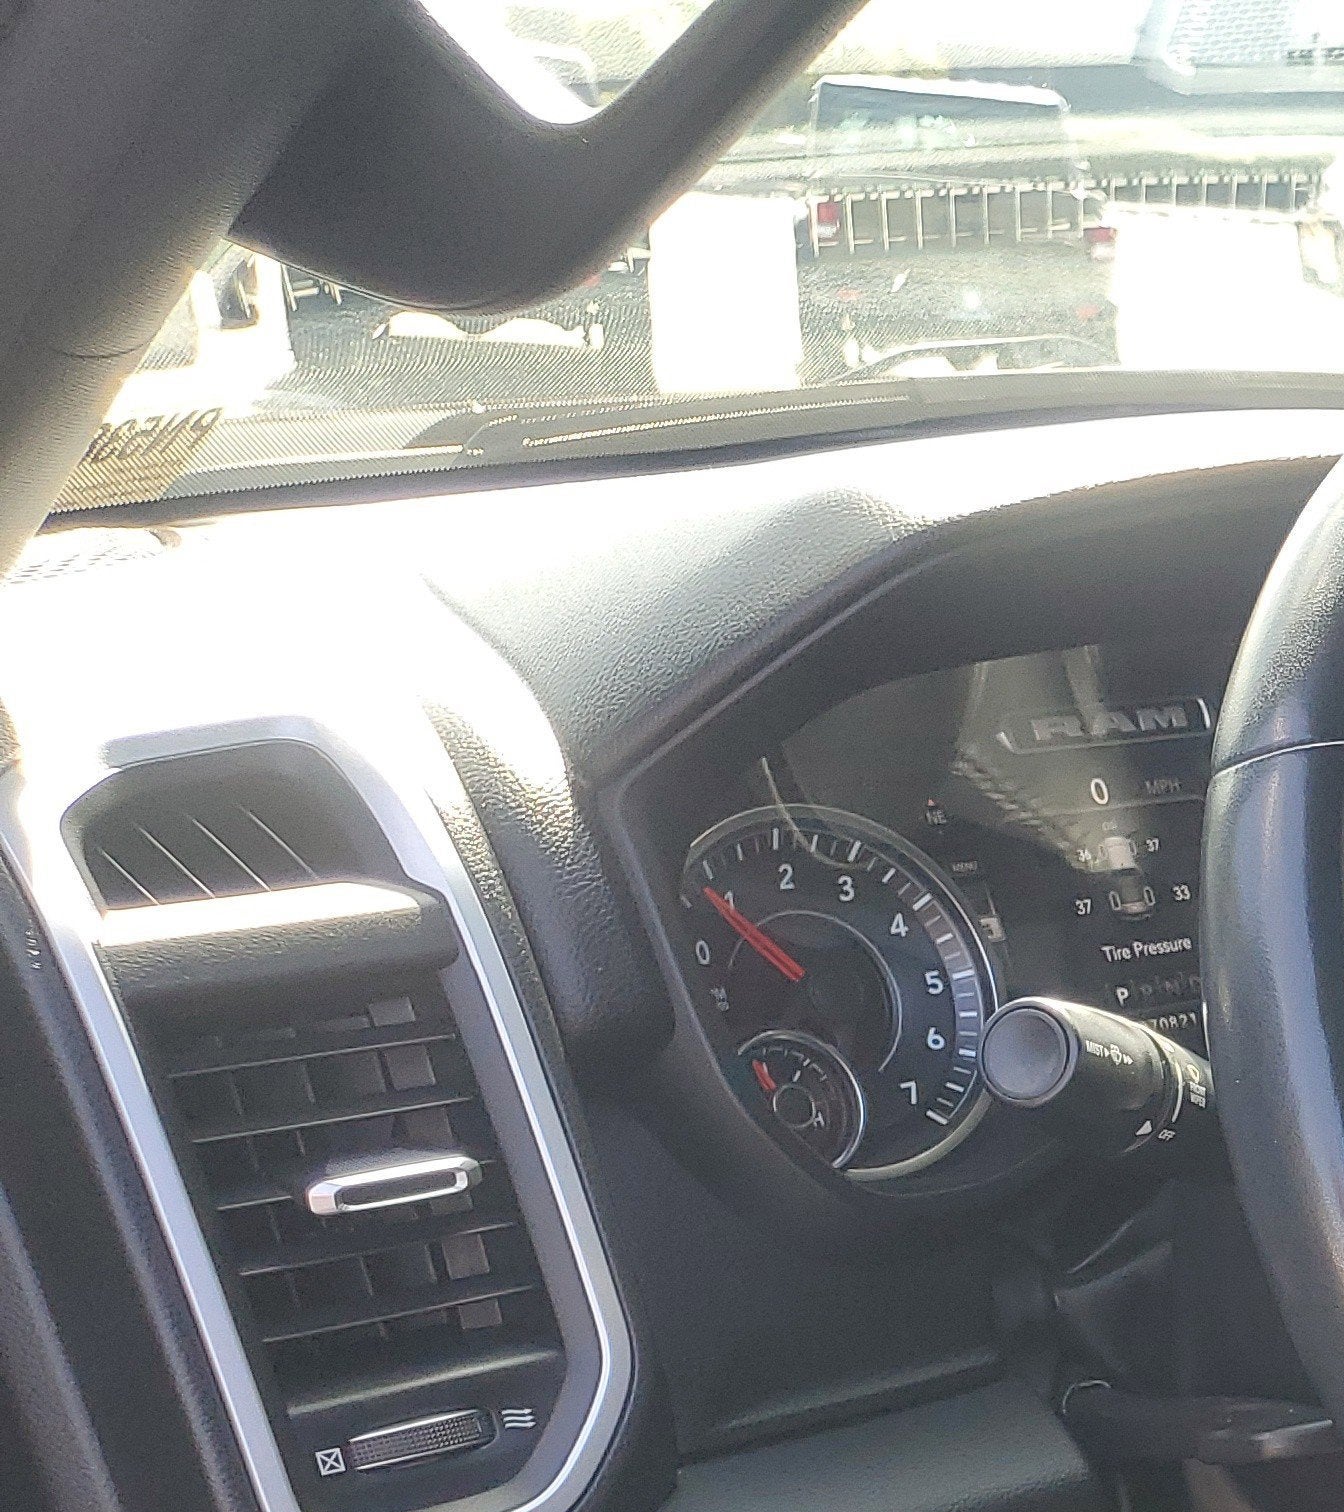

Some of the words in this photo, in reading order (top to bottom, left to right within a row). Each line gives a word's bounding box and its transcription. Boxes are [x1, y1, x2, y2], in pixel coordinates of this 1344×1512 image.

[1031, 706, 1189, 741] RAM
[1090, 777, 1109, 805] 0
[778, 864, 796, 890] 2
[836, 876, 855, 901] 3
[1075, 899, 1092, 915] 37
[1172, 884, 1191, 901] 33
[889, 913, 909, 938] 4
[695, 940, 711, 966] 0
[1101, 944, 1132, 963] Tire
[1133, 937, 1194, 959] Pressure
[924, 970, 945, 995] 5
[1115, 986, 1130, 1007] P
[926, 1027, 946, 1050] 6
[1085, 1040, 1104, 1058] MIST
[900, 1080, 918, 1105] 7
[1158, 1129, 1176, 1141] OFF
